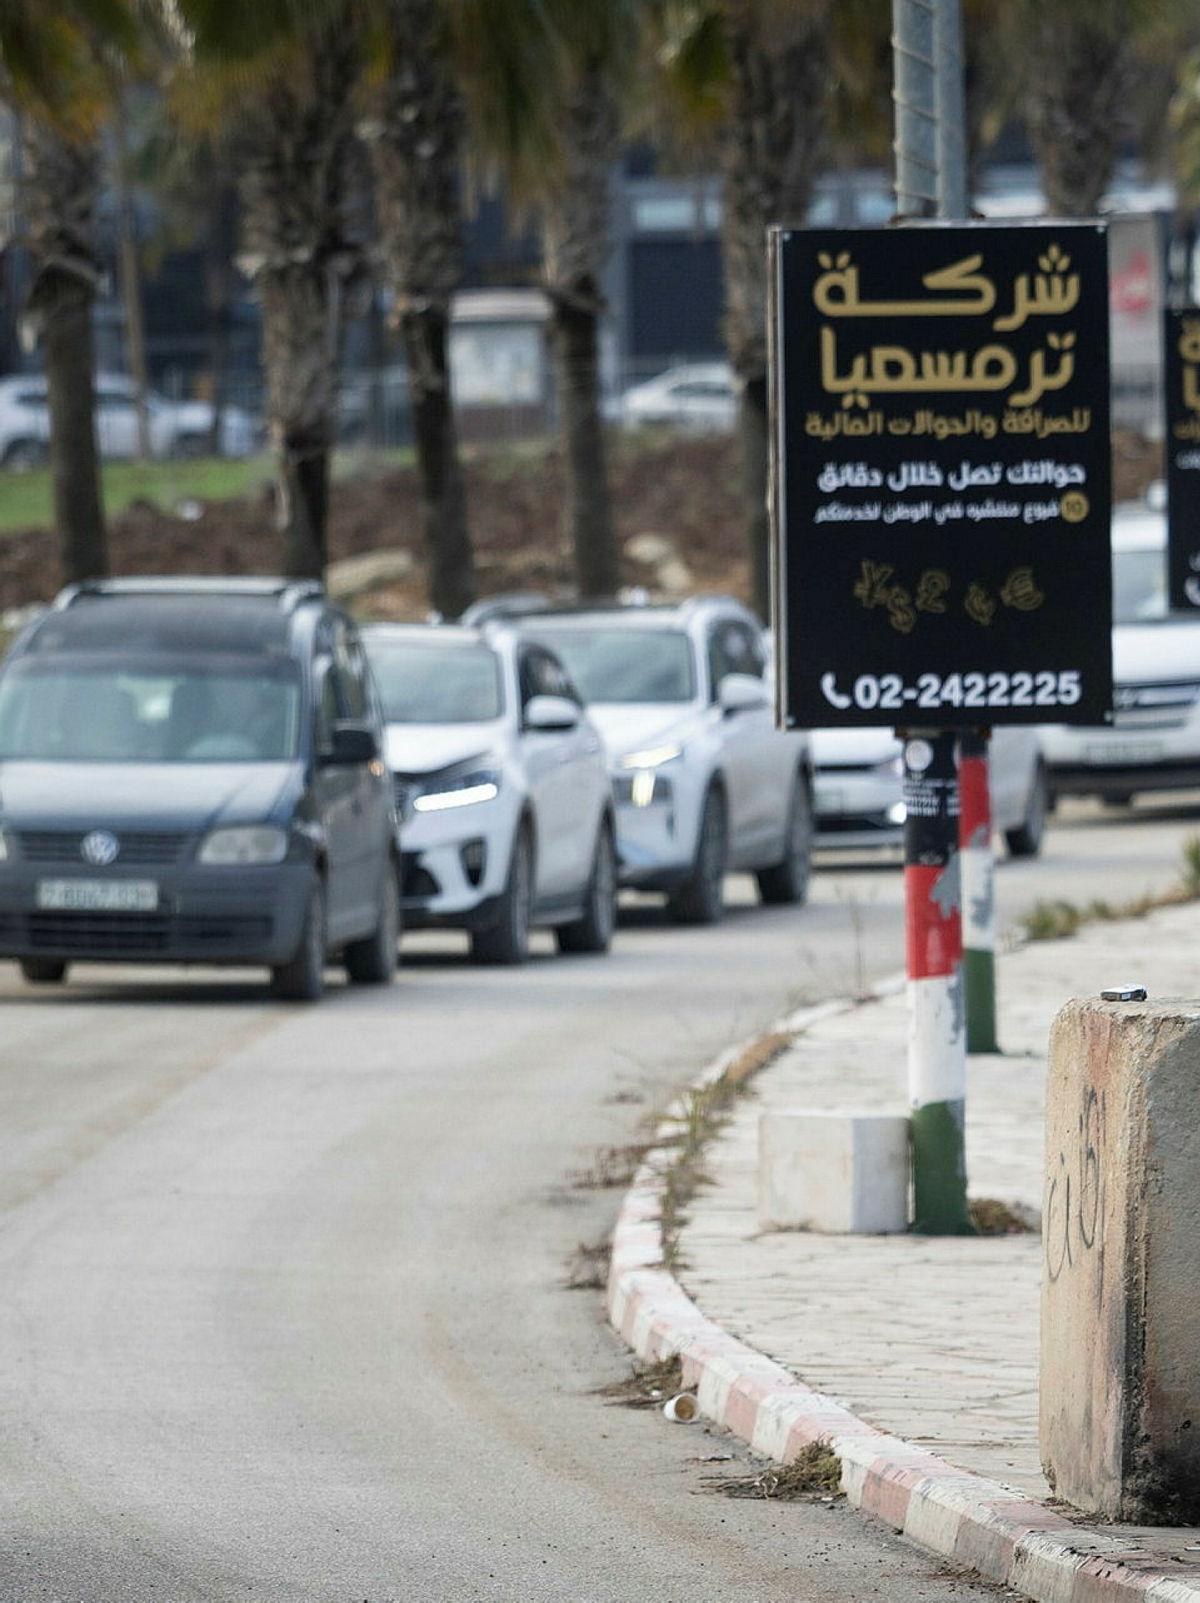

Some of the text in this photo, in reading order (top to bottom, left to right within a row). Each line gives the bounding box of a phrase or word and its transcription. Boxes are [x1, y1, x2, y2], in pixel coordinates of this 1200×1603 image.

[812, 243, 1082, 332] شركة
[820, 325, 1078, 410] ترمسعيا
[804, 408, 1092, 441] للصرافة والحوالات المالية
[854, 670, 1083, 710] 02-2422225
